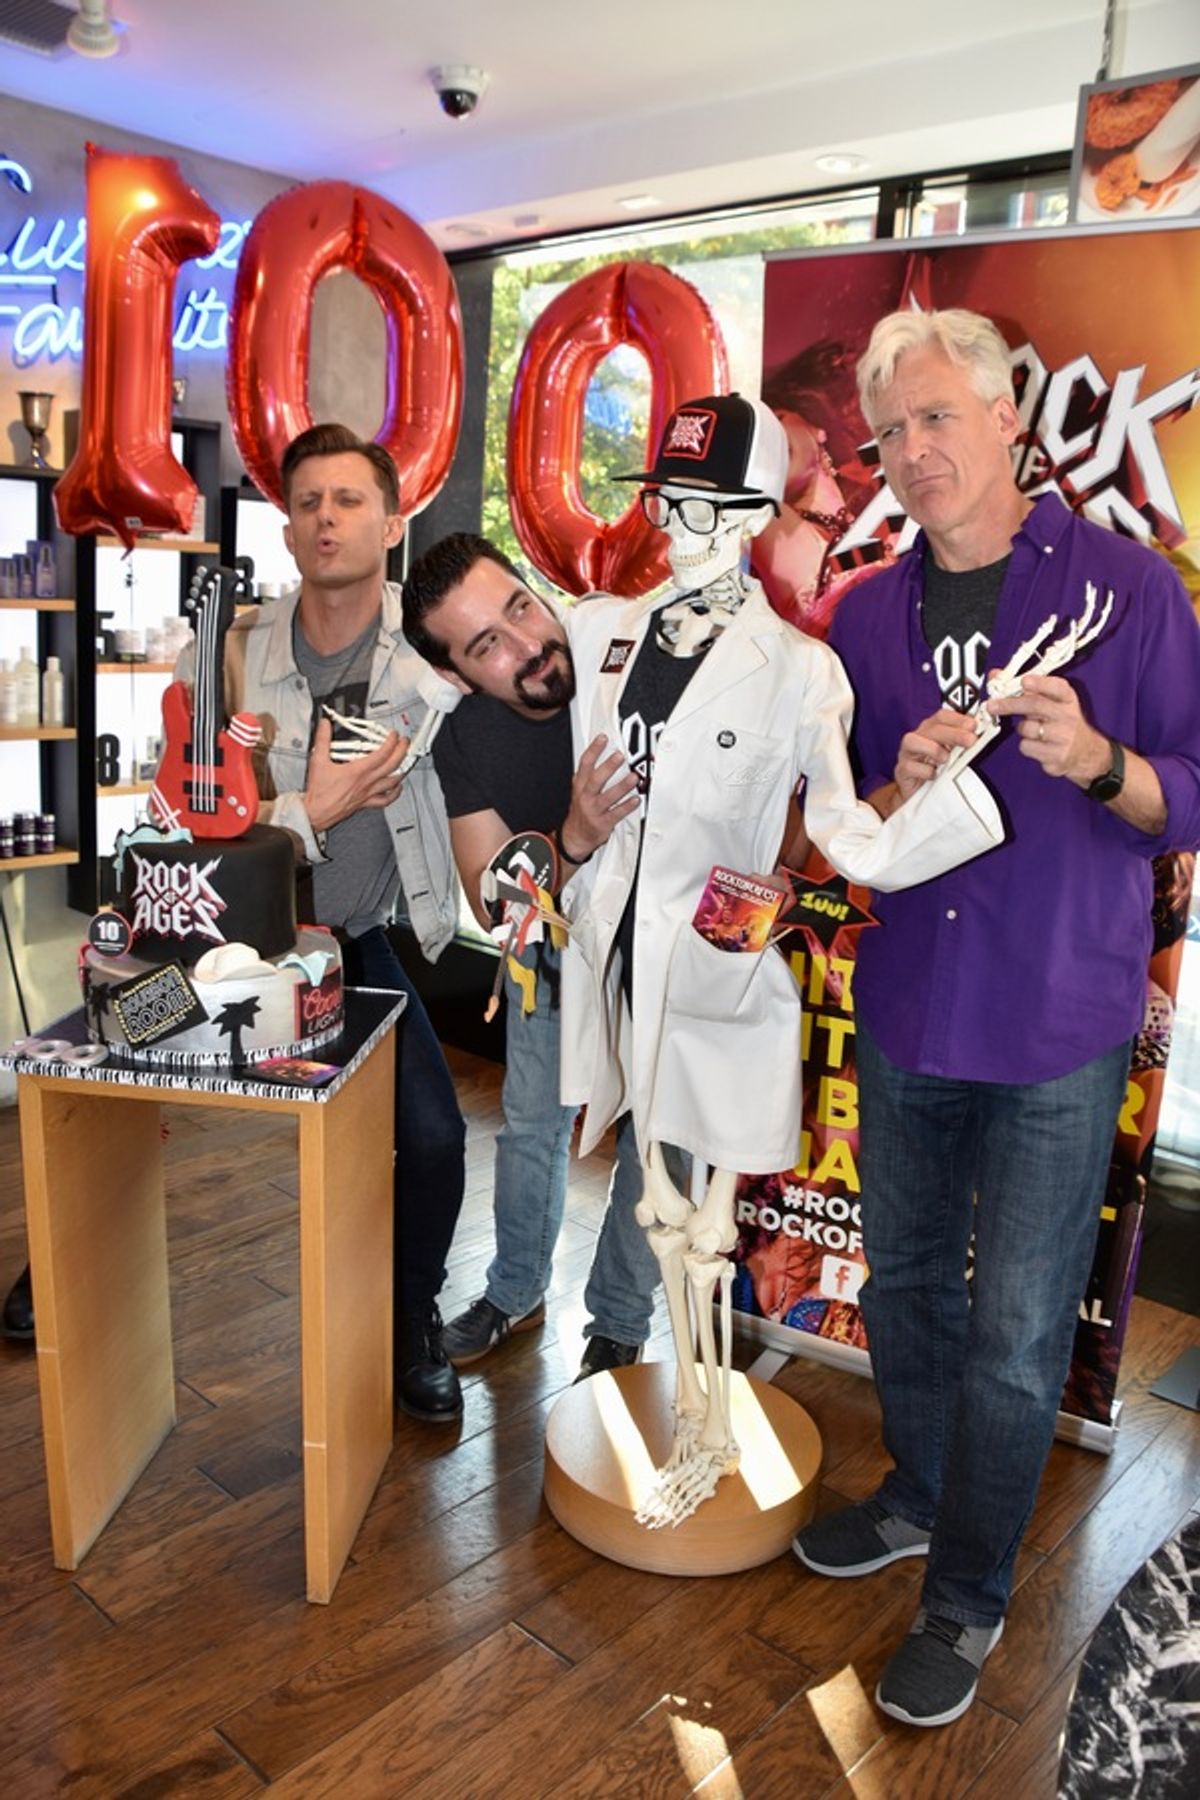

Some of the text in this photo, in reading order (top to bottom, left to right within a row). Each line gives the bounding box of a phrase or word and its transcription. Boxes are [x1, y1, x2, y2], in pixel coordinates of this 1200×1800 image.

[933, 631, 992, 693] OC
[98, 733, 120, 787] 8
[129, 848, 228, 913] ROCK
[131, 894, 228, 944] AGES
